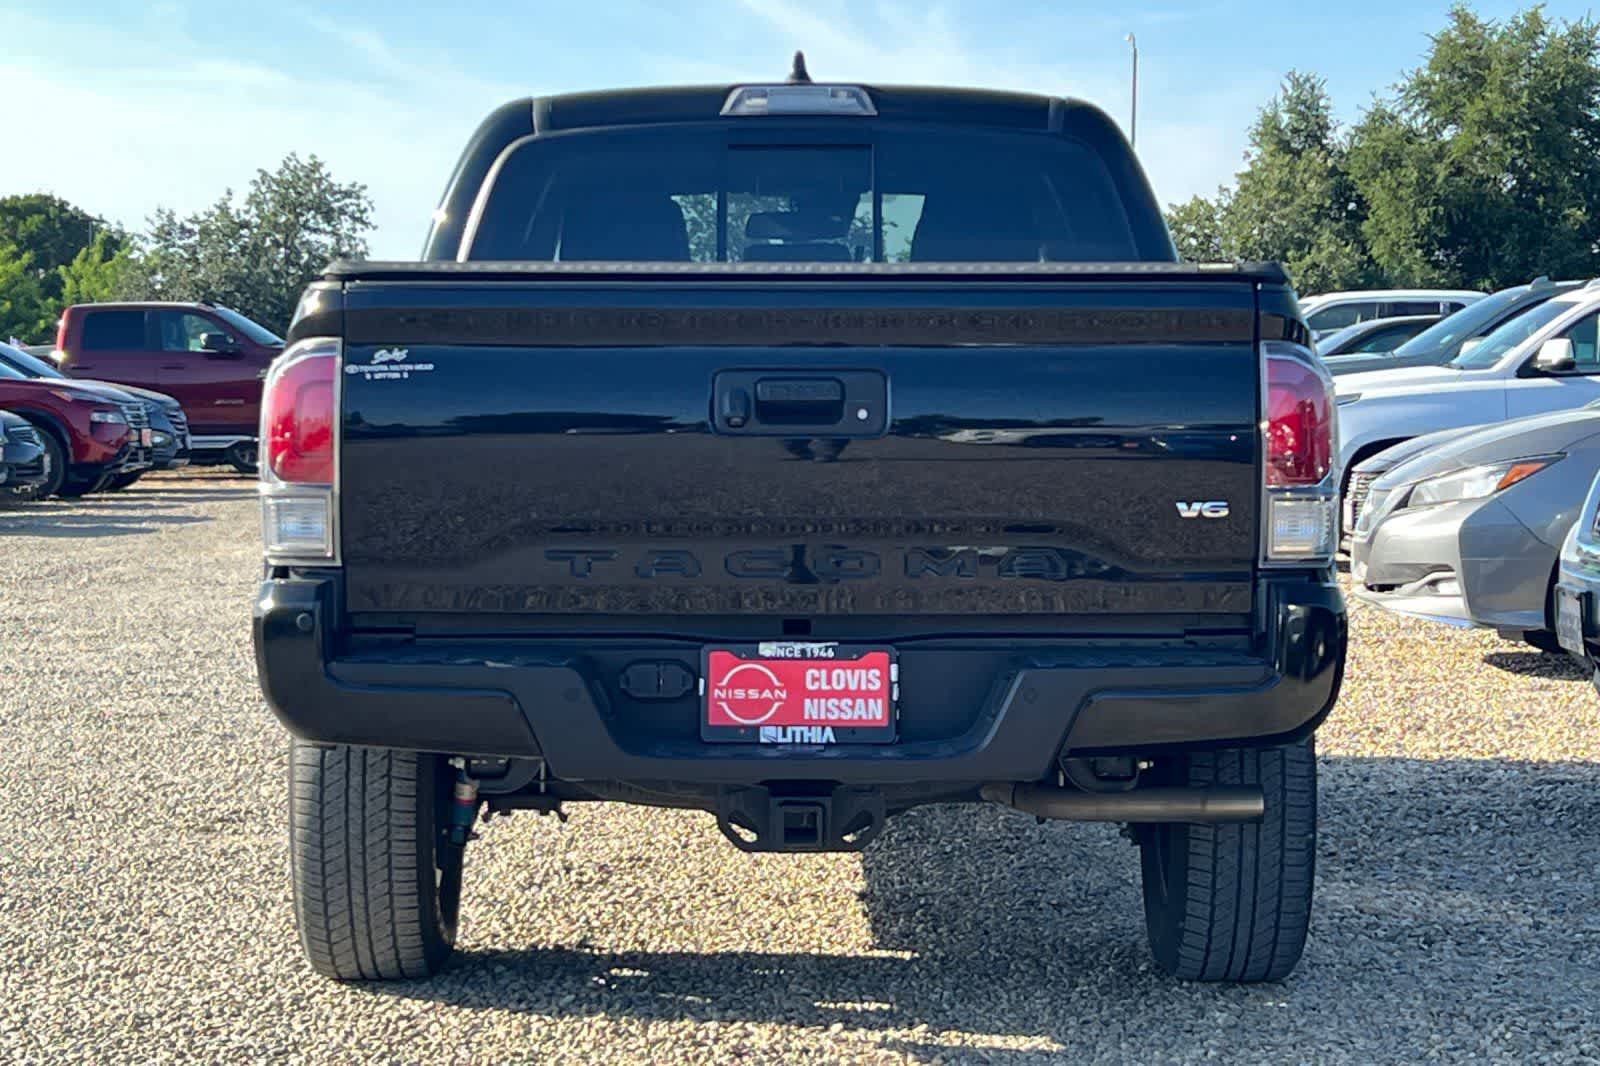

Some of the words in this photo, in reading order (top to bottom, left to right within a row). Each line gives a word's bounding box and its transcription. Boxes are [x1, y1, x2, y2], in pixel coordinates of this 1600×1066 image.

[1176, 502, 1229, 517] V6
[544, 547, 1068, 579] TACOMA
[806, 647, 834, 658] 1946
[805, 669, 882, 691] CLOVIS
[714, 688, 787, 699] NISSAN
[804, 698, 882, 720] NISSAN
[777, 726, 836, 743] LITHIA
